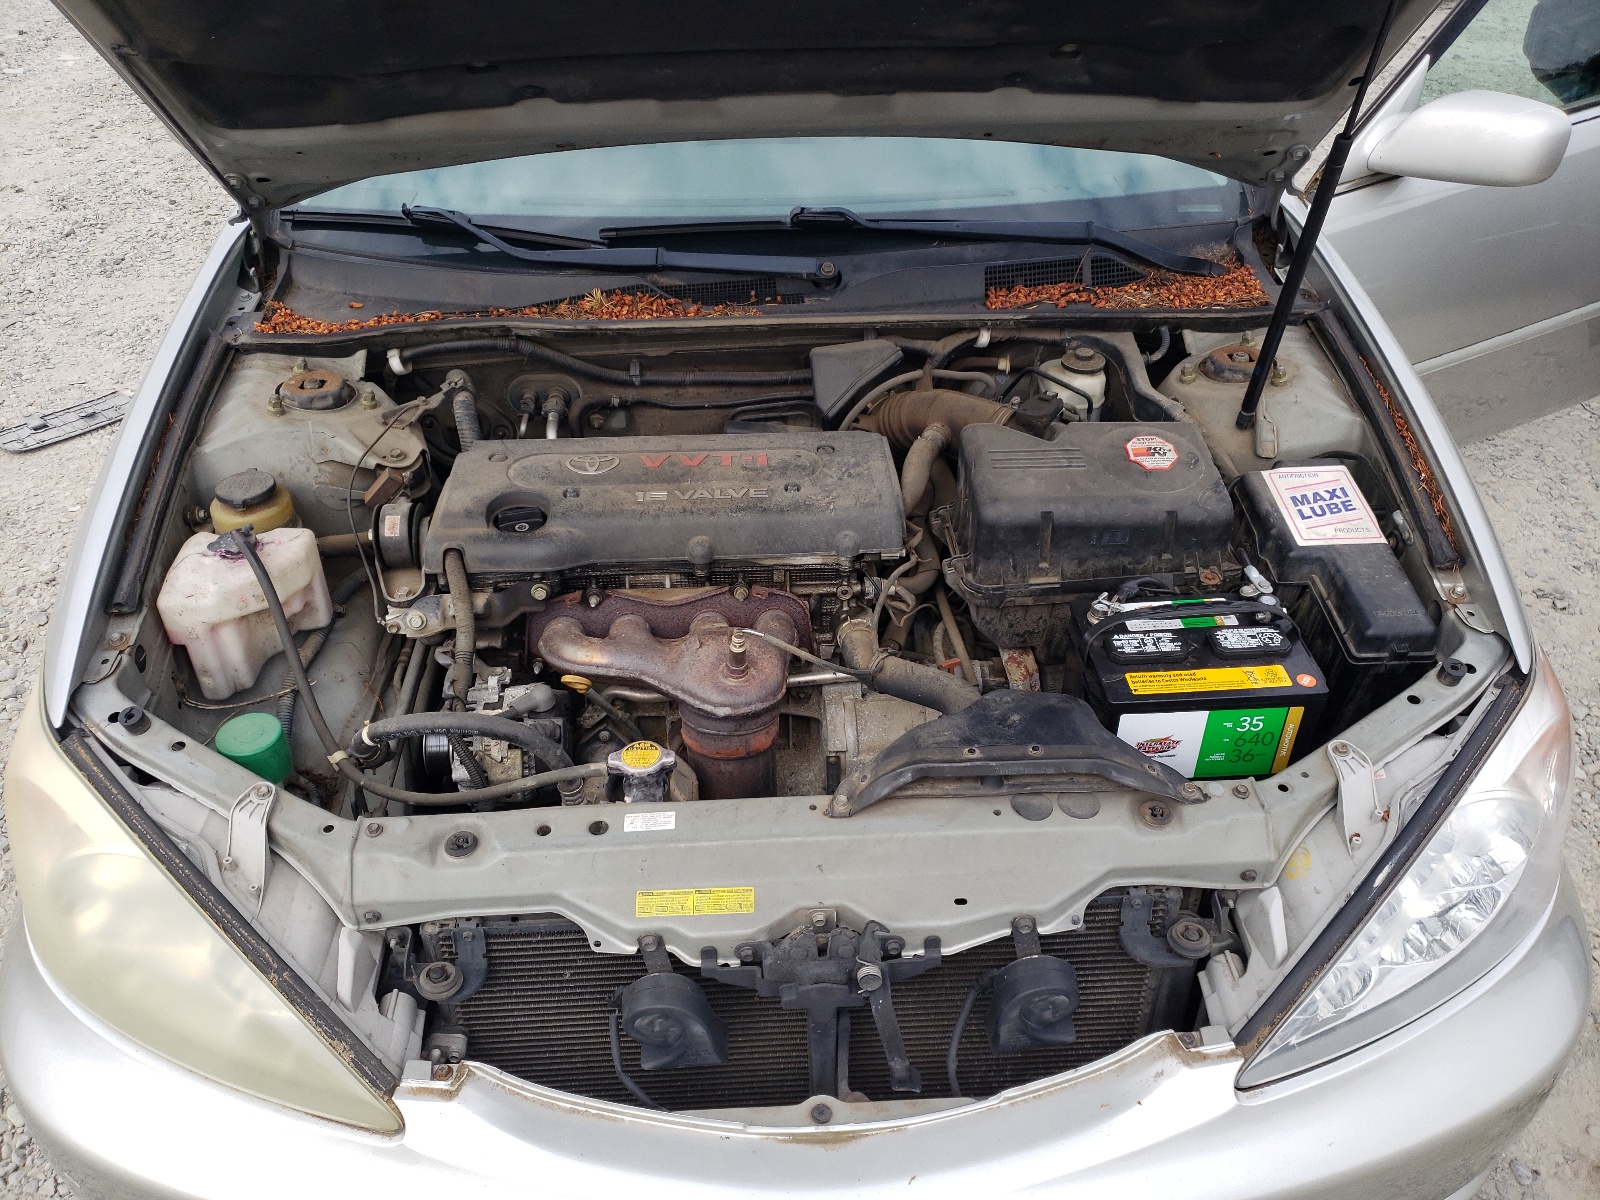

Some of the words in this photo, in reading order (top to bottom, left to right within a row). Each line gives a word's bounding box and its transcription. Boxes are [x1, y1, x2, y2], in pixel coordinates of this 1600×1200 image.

[635, 491, 668, 502] 16
[673, 488, 769, 501] VALVE
[1289, 486, 1350, 508] MAXI
[1296, 499, 1357, 521] LUBE
[1236, 715, 1265, 732] 35
[1234, 731, 1275, 748] 640
[1280, 723, 1295, 757] AUTOMOTIVE
